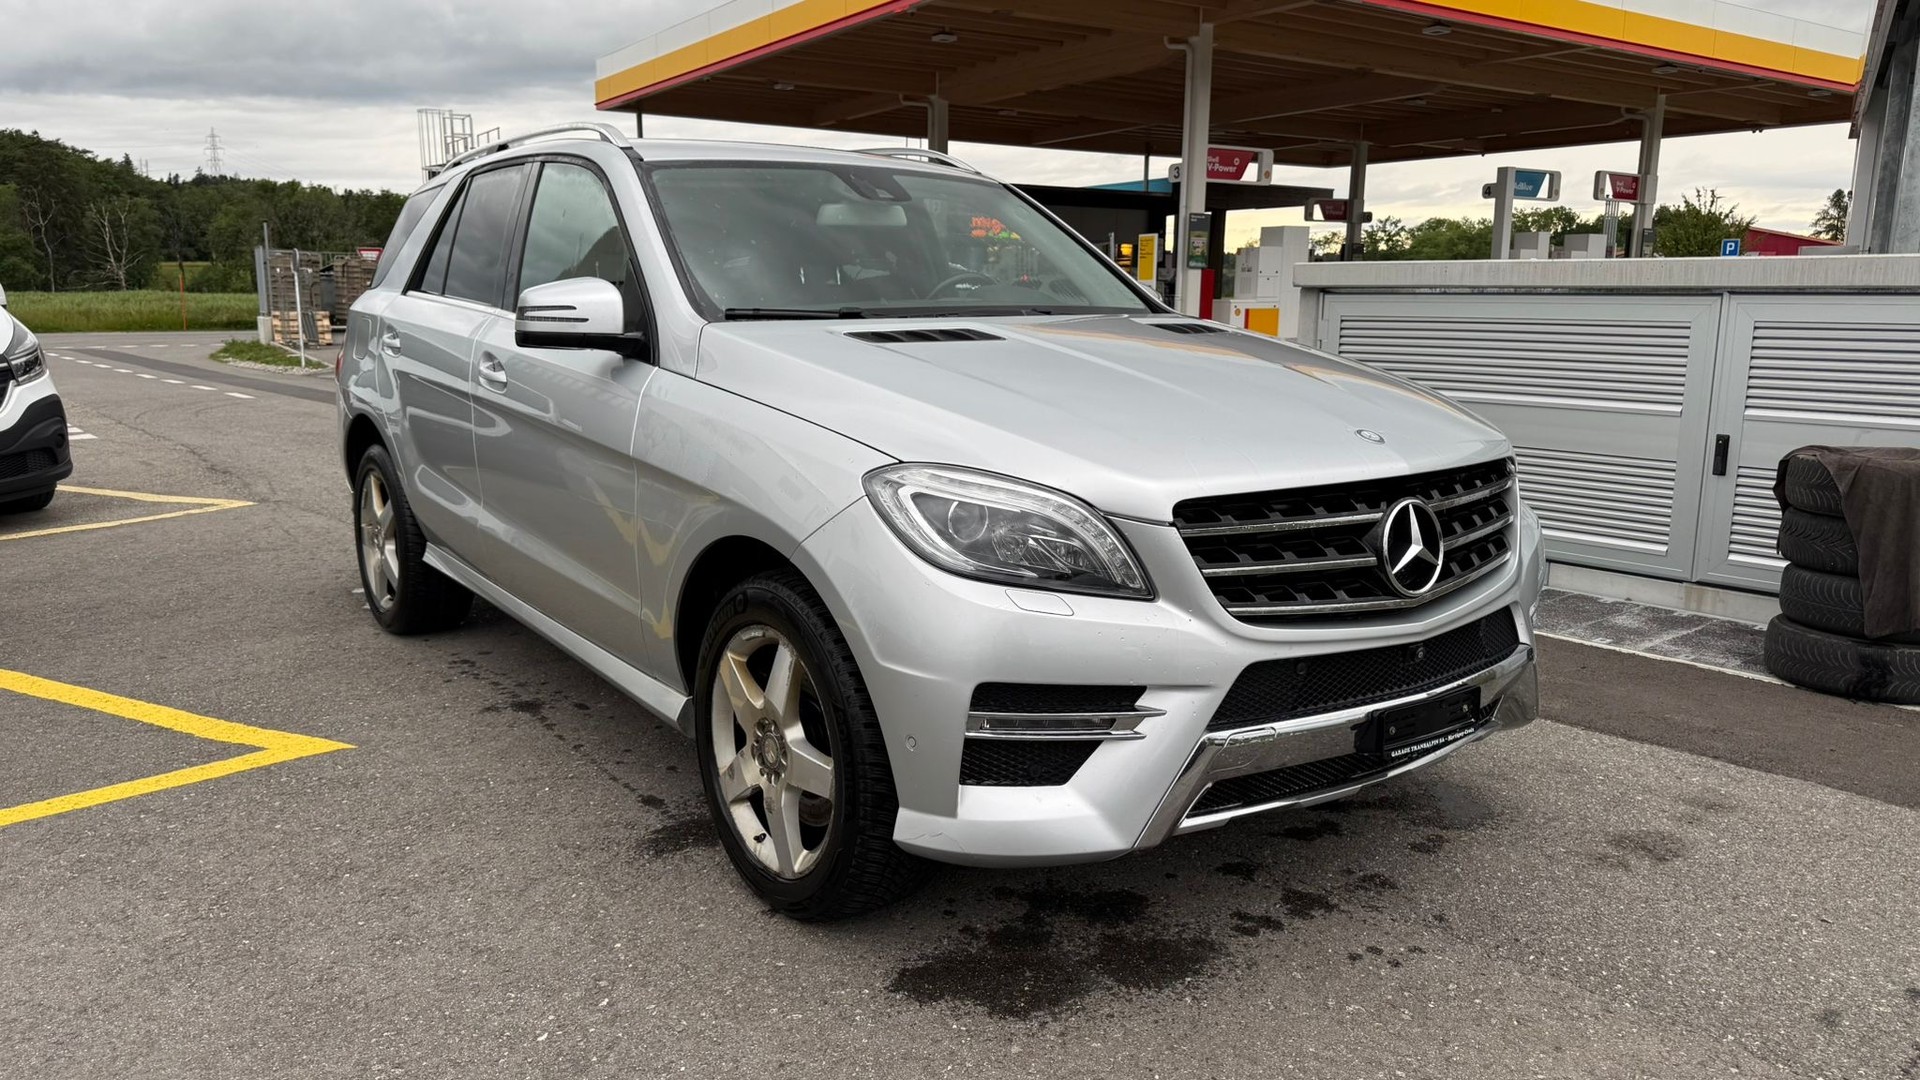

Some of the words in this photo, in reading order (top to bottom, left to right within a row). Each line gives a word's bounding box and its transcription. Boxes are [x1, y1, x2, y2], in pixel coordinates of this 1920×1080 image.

[1173, 166, 1181, 179] 3
[1208, 163, 1237, 173] V-Power
[1484, 186, 1493, 198] 4
[1726, 243, 1735, 255] P
[1391, 747, 1411, 757] GARAGE
